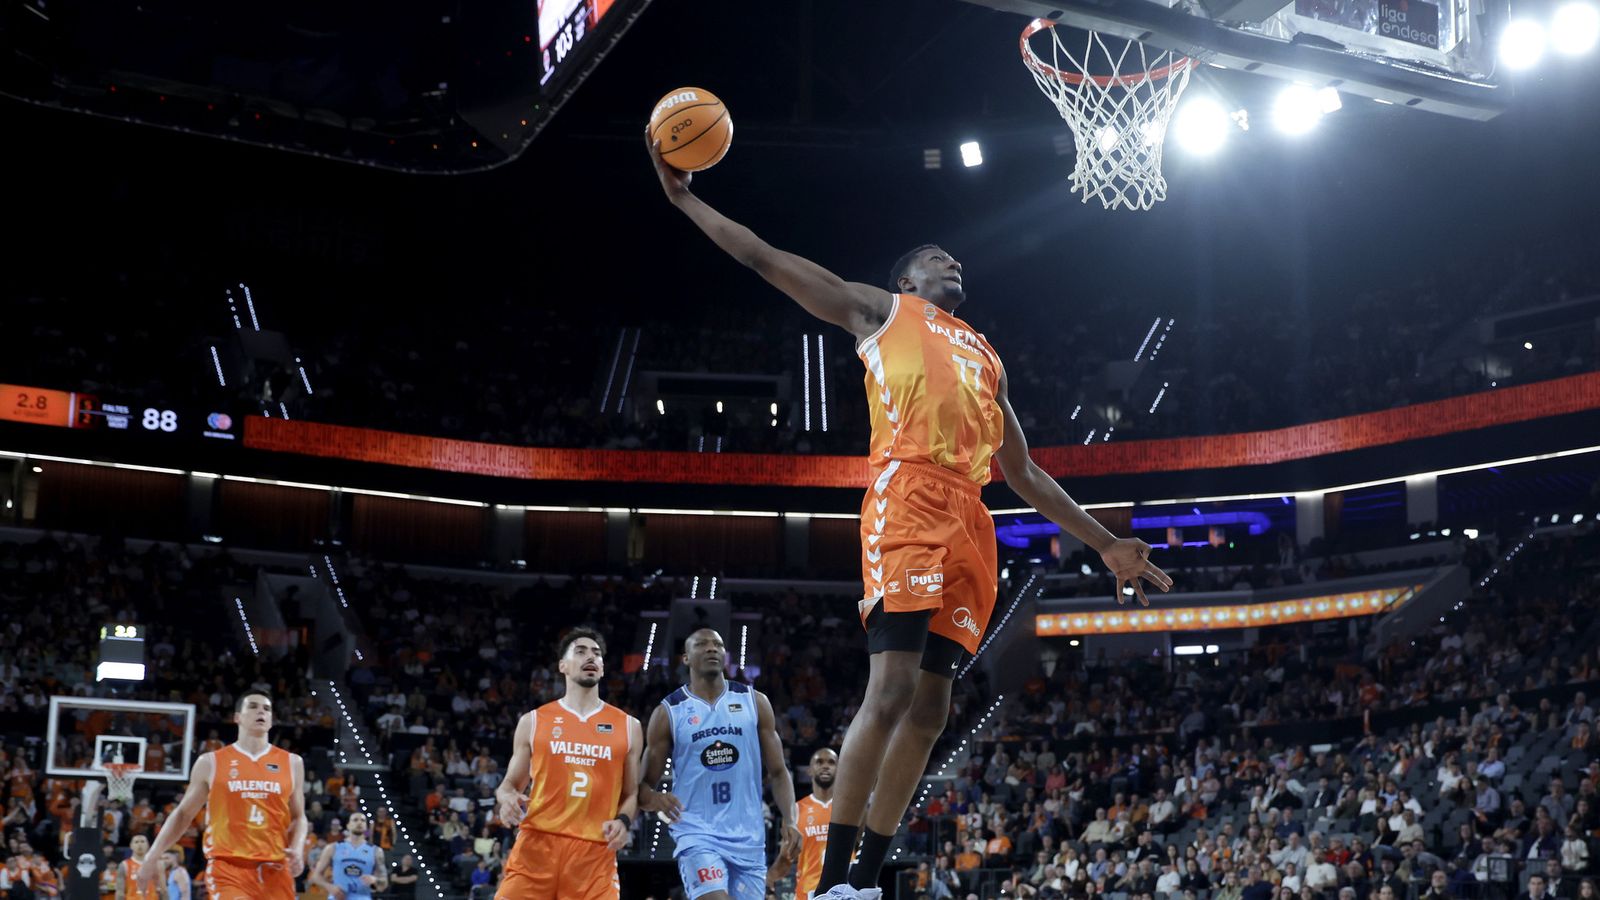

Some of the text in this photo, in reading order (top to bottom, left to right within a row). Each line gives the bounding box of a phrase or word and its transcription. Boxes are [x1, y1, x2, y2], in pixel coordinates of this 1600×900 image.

[1381, 4, 1407, 23] liga
[1382, 22, 1437, 45] endesa
[671, 118, 693, 134] acb
[952, 354, 983, 391] 77
[16, 393, 48, 410] 2.8
[142, 408, 178, 432] 88
[691, 723, 743, 743] BREOGÁN
[549, 741, 612, 761] VALENCIA
[564, 755, 597, 767] BASKET
[706, 748, 733, 758] Estrella
[707, 755, 733, 765] Galicia
[227, 780, 282, 795] VALENCIA
[570, 771, 589, 798] 2
[711, 781, 731, 805] 18
[248, 804, 265, 826] 4
